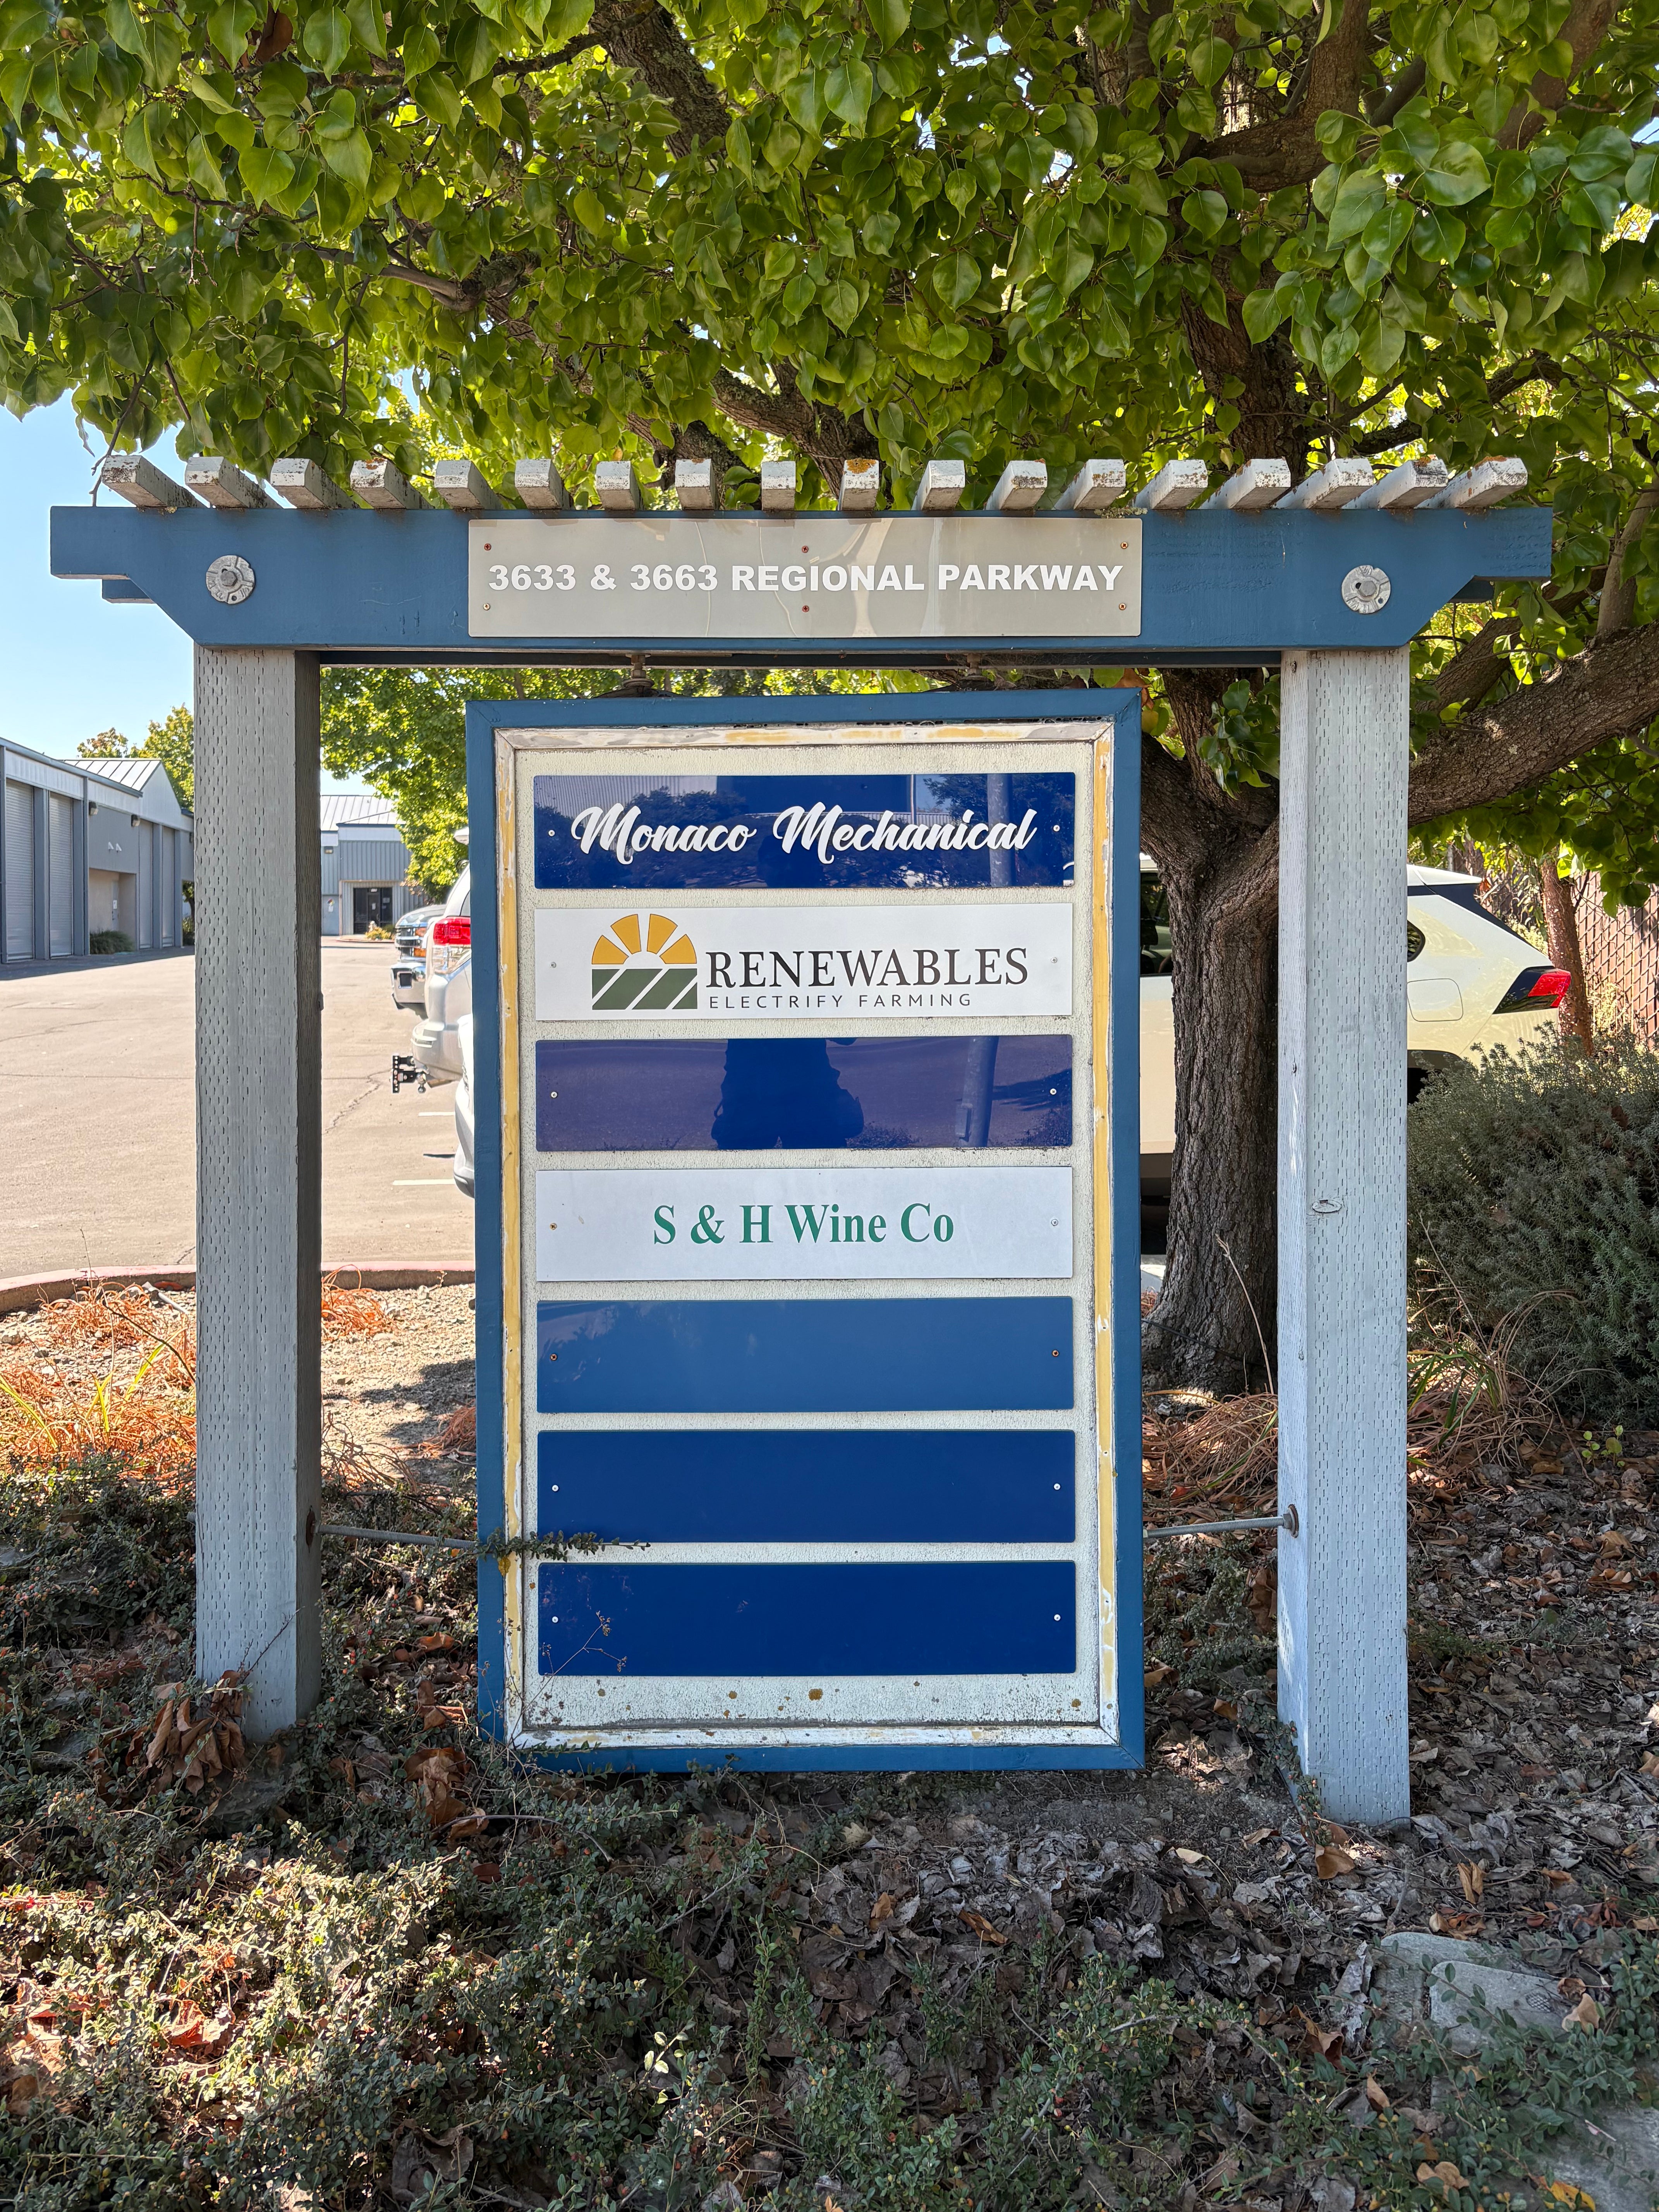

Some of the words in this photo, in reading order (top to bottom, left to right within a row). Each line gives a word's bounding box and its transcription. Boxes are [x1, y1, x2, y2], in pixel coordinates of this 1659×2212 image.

[488, 564, 576, 591] 3633
[590, 564, 617, 591] &
[630, 564, 718, 591] 3663
[732, 565, 925, 592] REGIONAL
[938, 564, 1124, 591] PARKWAY
[571, 802, 757, 865] Monaco
[773, 801, 1037, 864] Mechanical
[705, 947, 1028, 989] RENEWABLES
[709, 995, 843, 1009] ELECTRIFY
[859, 993, 971, 1008] FARMING
[654, 1204, 676, 1245] S
[690, 1204, 725, 1245] &
[738, 1205, 774, 1243] H
[783, 1203, 887, 1244] Wine
[900, 1202, 954, 1243] Co
